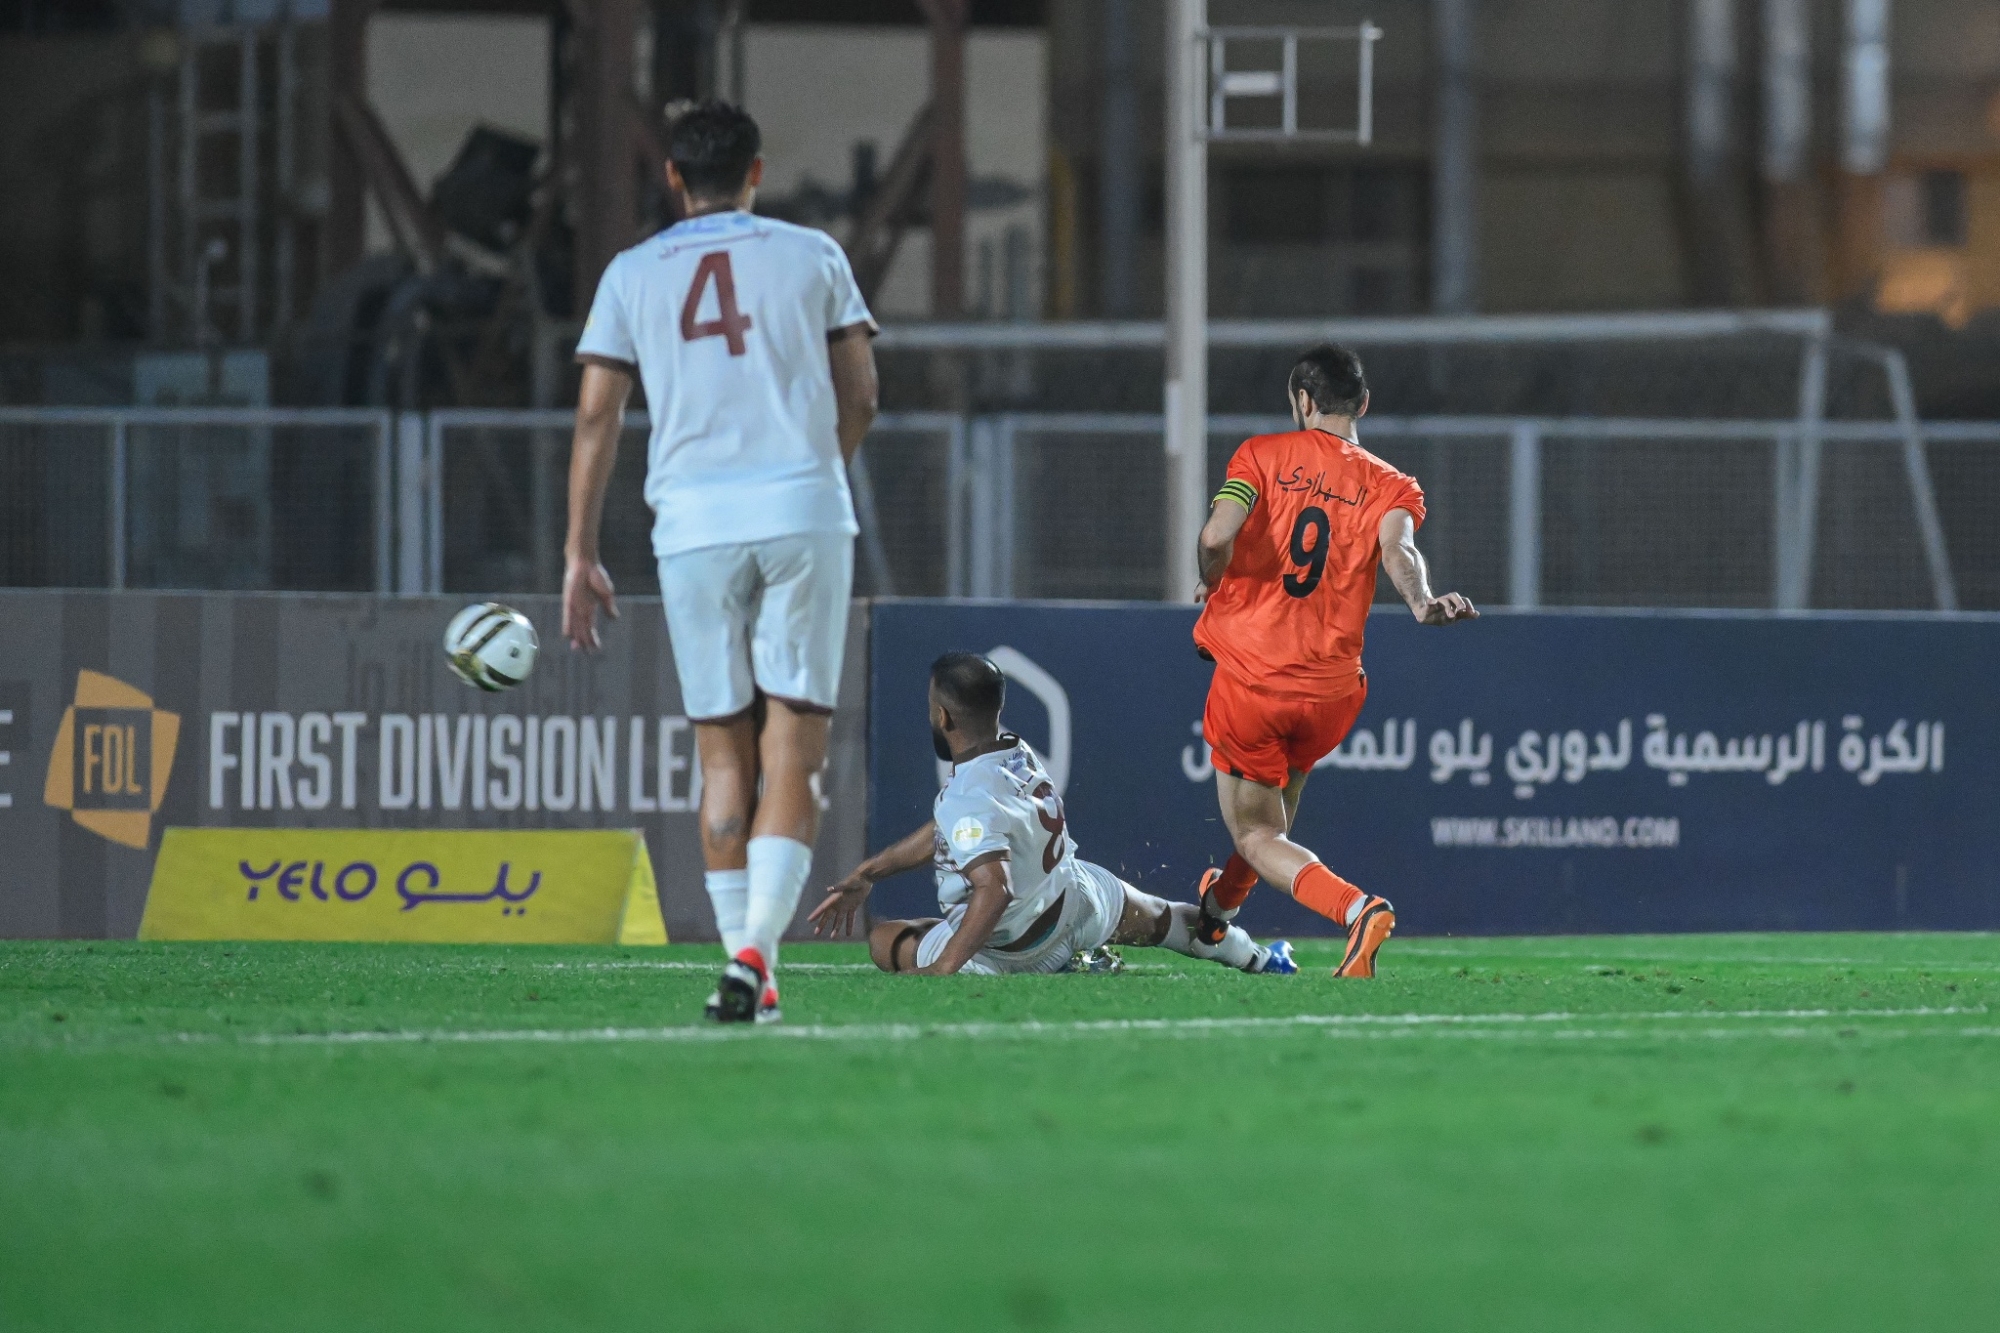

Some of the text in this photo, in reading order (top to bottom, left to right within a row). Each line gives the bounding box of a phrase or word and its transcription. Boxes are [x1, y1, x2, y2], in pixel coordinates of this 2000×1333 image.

[681, 250, 752, 356] 4
[1277, 466, 1368, 507] السهلاوي
[1283, 506, 1331, 599] 9
[83, 724, 142, 794] FDL
[209, 711, 367, 810] FIRST
[379, 712, 617, 812] DIVISION
[1428, 717, 1494, 786] يلو
[1505, 717, 1634, 800] لدوري
[1643, 713, 1826, 786] الرسمية
[1838, 713, 1945, 786] الكرة
[1032, 780, 1066, 875] 8
[239, 860, 378, 901] YELO
